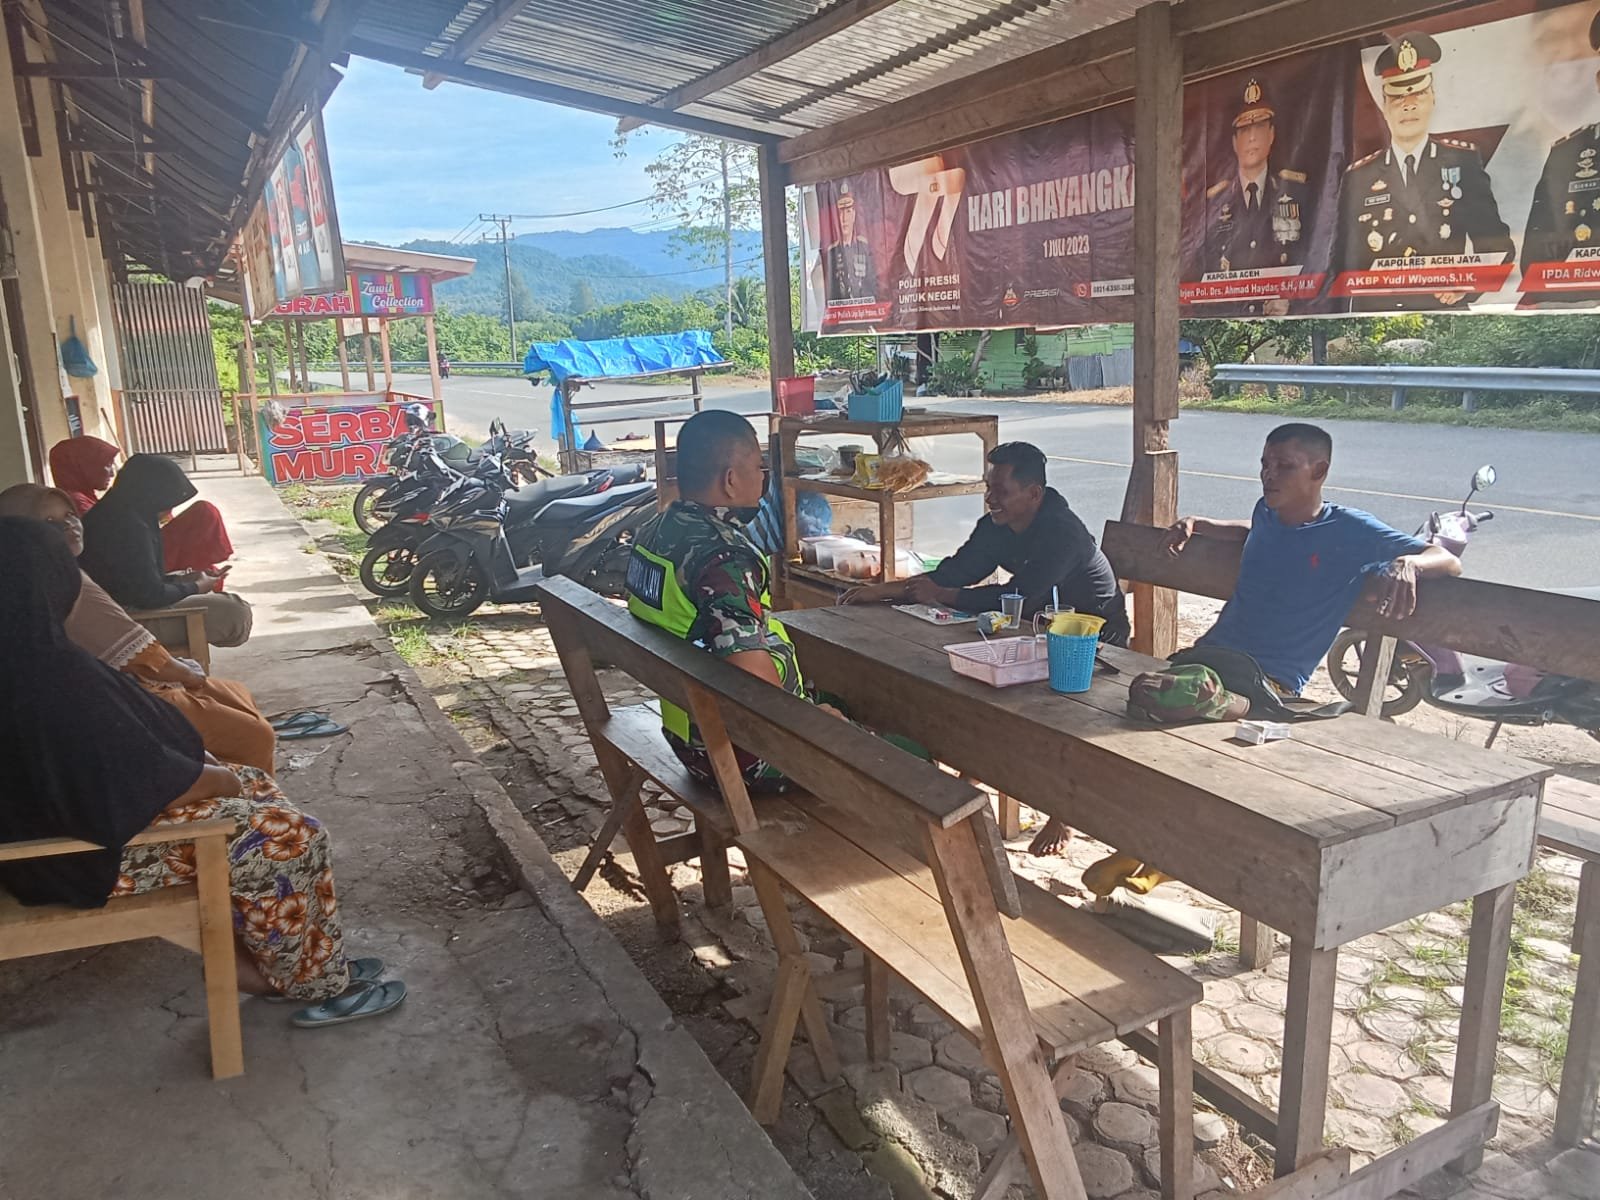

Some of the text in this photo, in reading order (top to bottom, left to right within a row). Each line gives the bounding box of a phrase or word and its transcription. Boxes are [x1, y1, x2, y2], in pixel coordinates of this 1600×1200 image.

[968, 189, 1011, 232] HARI
[1043, 235, 1090, 258] 1 JULI 2023
[1377, 255, 1482, 268] KAPOLRES ACEH JAYA
[1206, 270, 1260, 281] KAPOLDA ACEH
[1346, 276, 1379, 286] AKBP
[1382, 275, 1405, 285] Yudi
[1542, 269, 1569, 279] IPDA
[898, 274, 960, 290] POLRI PRESISI
[898, 289, 961, 304] UNTUK NEGERI
[1196, 287, 1209, 296] Pol.
[1225, 284, 1249, 295] Ahmad
[372, 295, 424, 308] Collection
